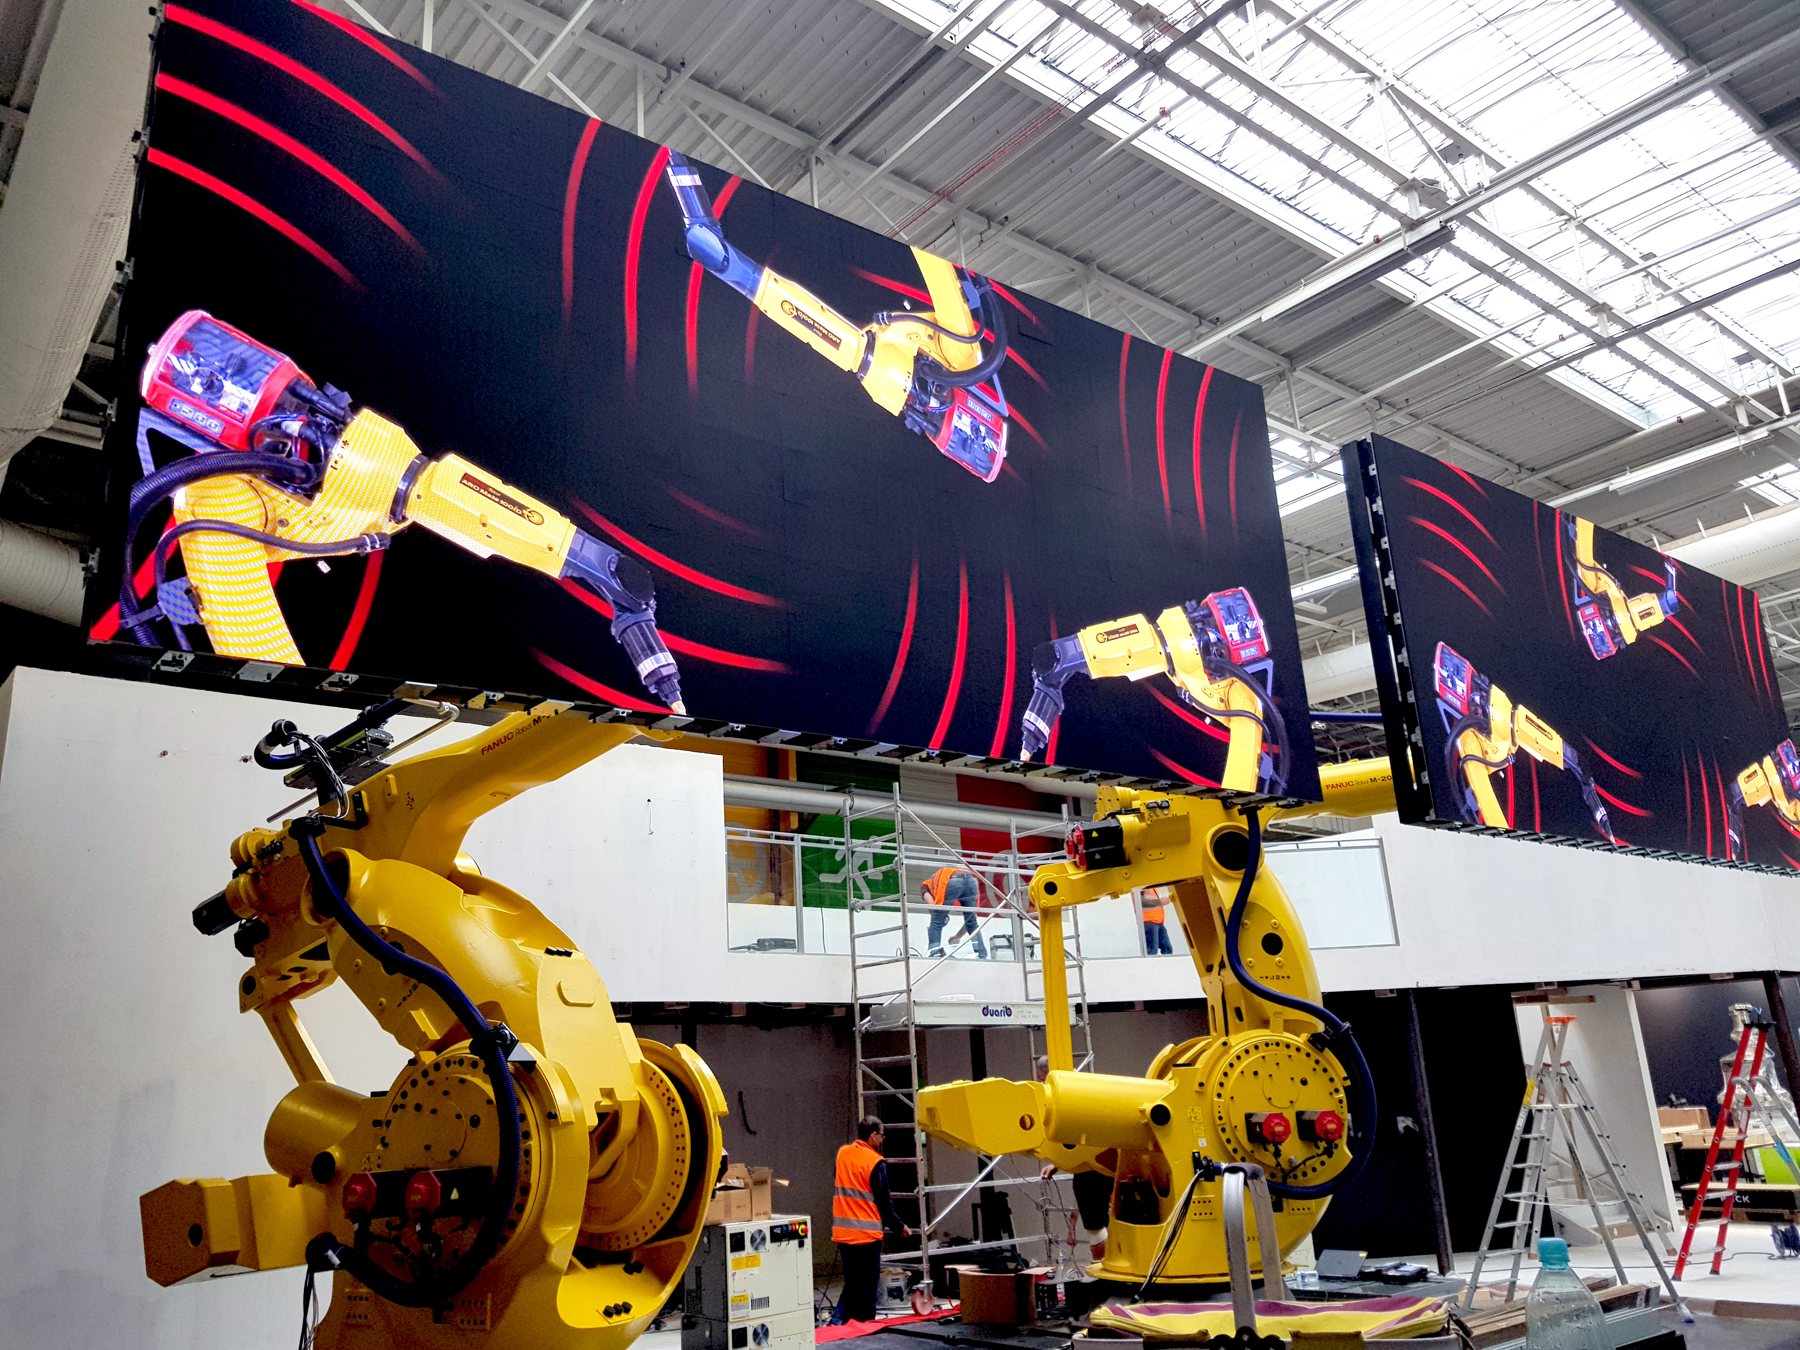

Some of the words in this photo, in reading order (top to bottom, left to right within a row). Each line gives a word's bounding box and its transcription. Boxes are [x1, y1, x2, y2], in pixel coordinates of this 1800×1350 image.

[480, 731, 514, 755] FANUC
[1325, 780, 1355, 790] FANUC
[981, 1005, 1013, 1018] duarib
